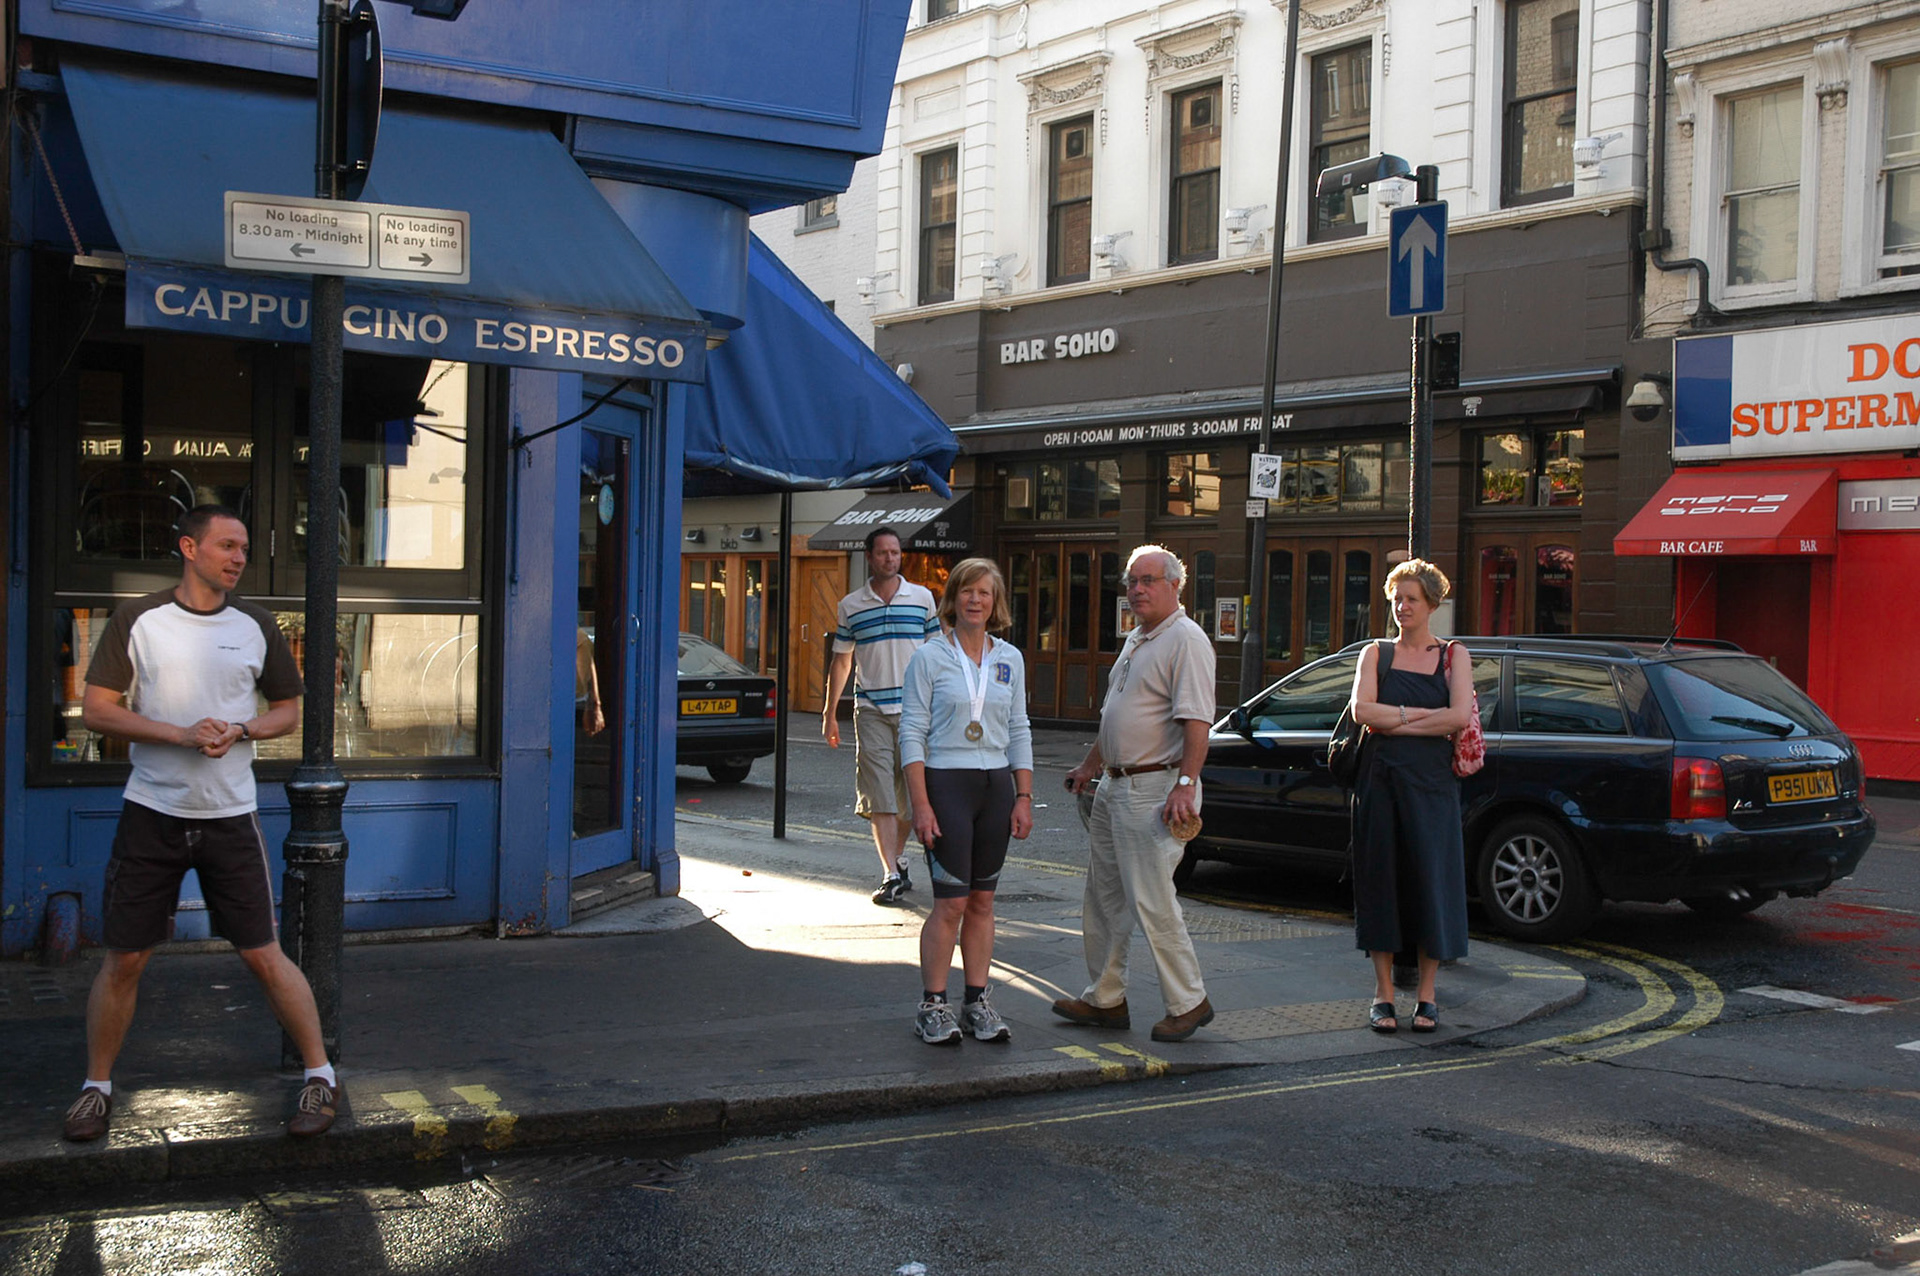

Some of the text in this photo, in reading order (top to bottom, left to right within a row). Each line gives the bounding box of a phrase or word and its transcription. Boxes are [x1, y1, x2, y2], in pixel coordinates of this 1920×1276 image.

[266, 209, 338, 227] No loading
[305, 228, 364, 245] Midnight
[386, 219, 455, 237] No loading
[384, 233, 458, 249] At any time
[154, 284, 684, 368] CAPPUCINO ESPRESSO
[1000, 327, 1118, 364] BAR SOHO
[1847, 337, 1920, 383] DO
[1044, 432, 1070, 446] OPEN
[1243, 416, 1262, 432] FRI
[833, 507, 943, 525] BAR SOHO
[915, 540, 968, 549] BAR SOHO
[1660, 541, 1724, 553] BAR CAFE
[1800, 540, 1817, 552] BAR
[687, 700, 731, 712] L47 TAP
[1774, 776, 1806, 799] P951
